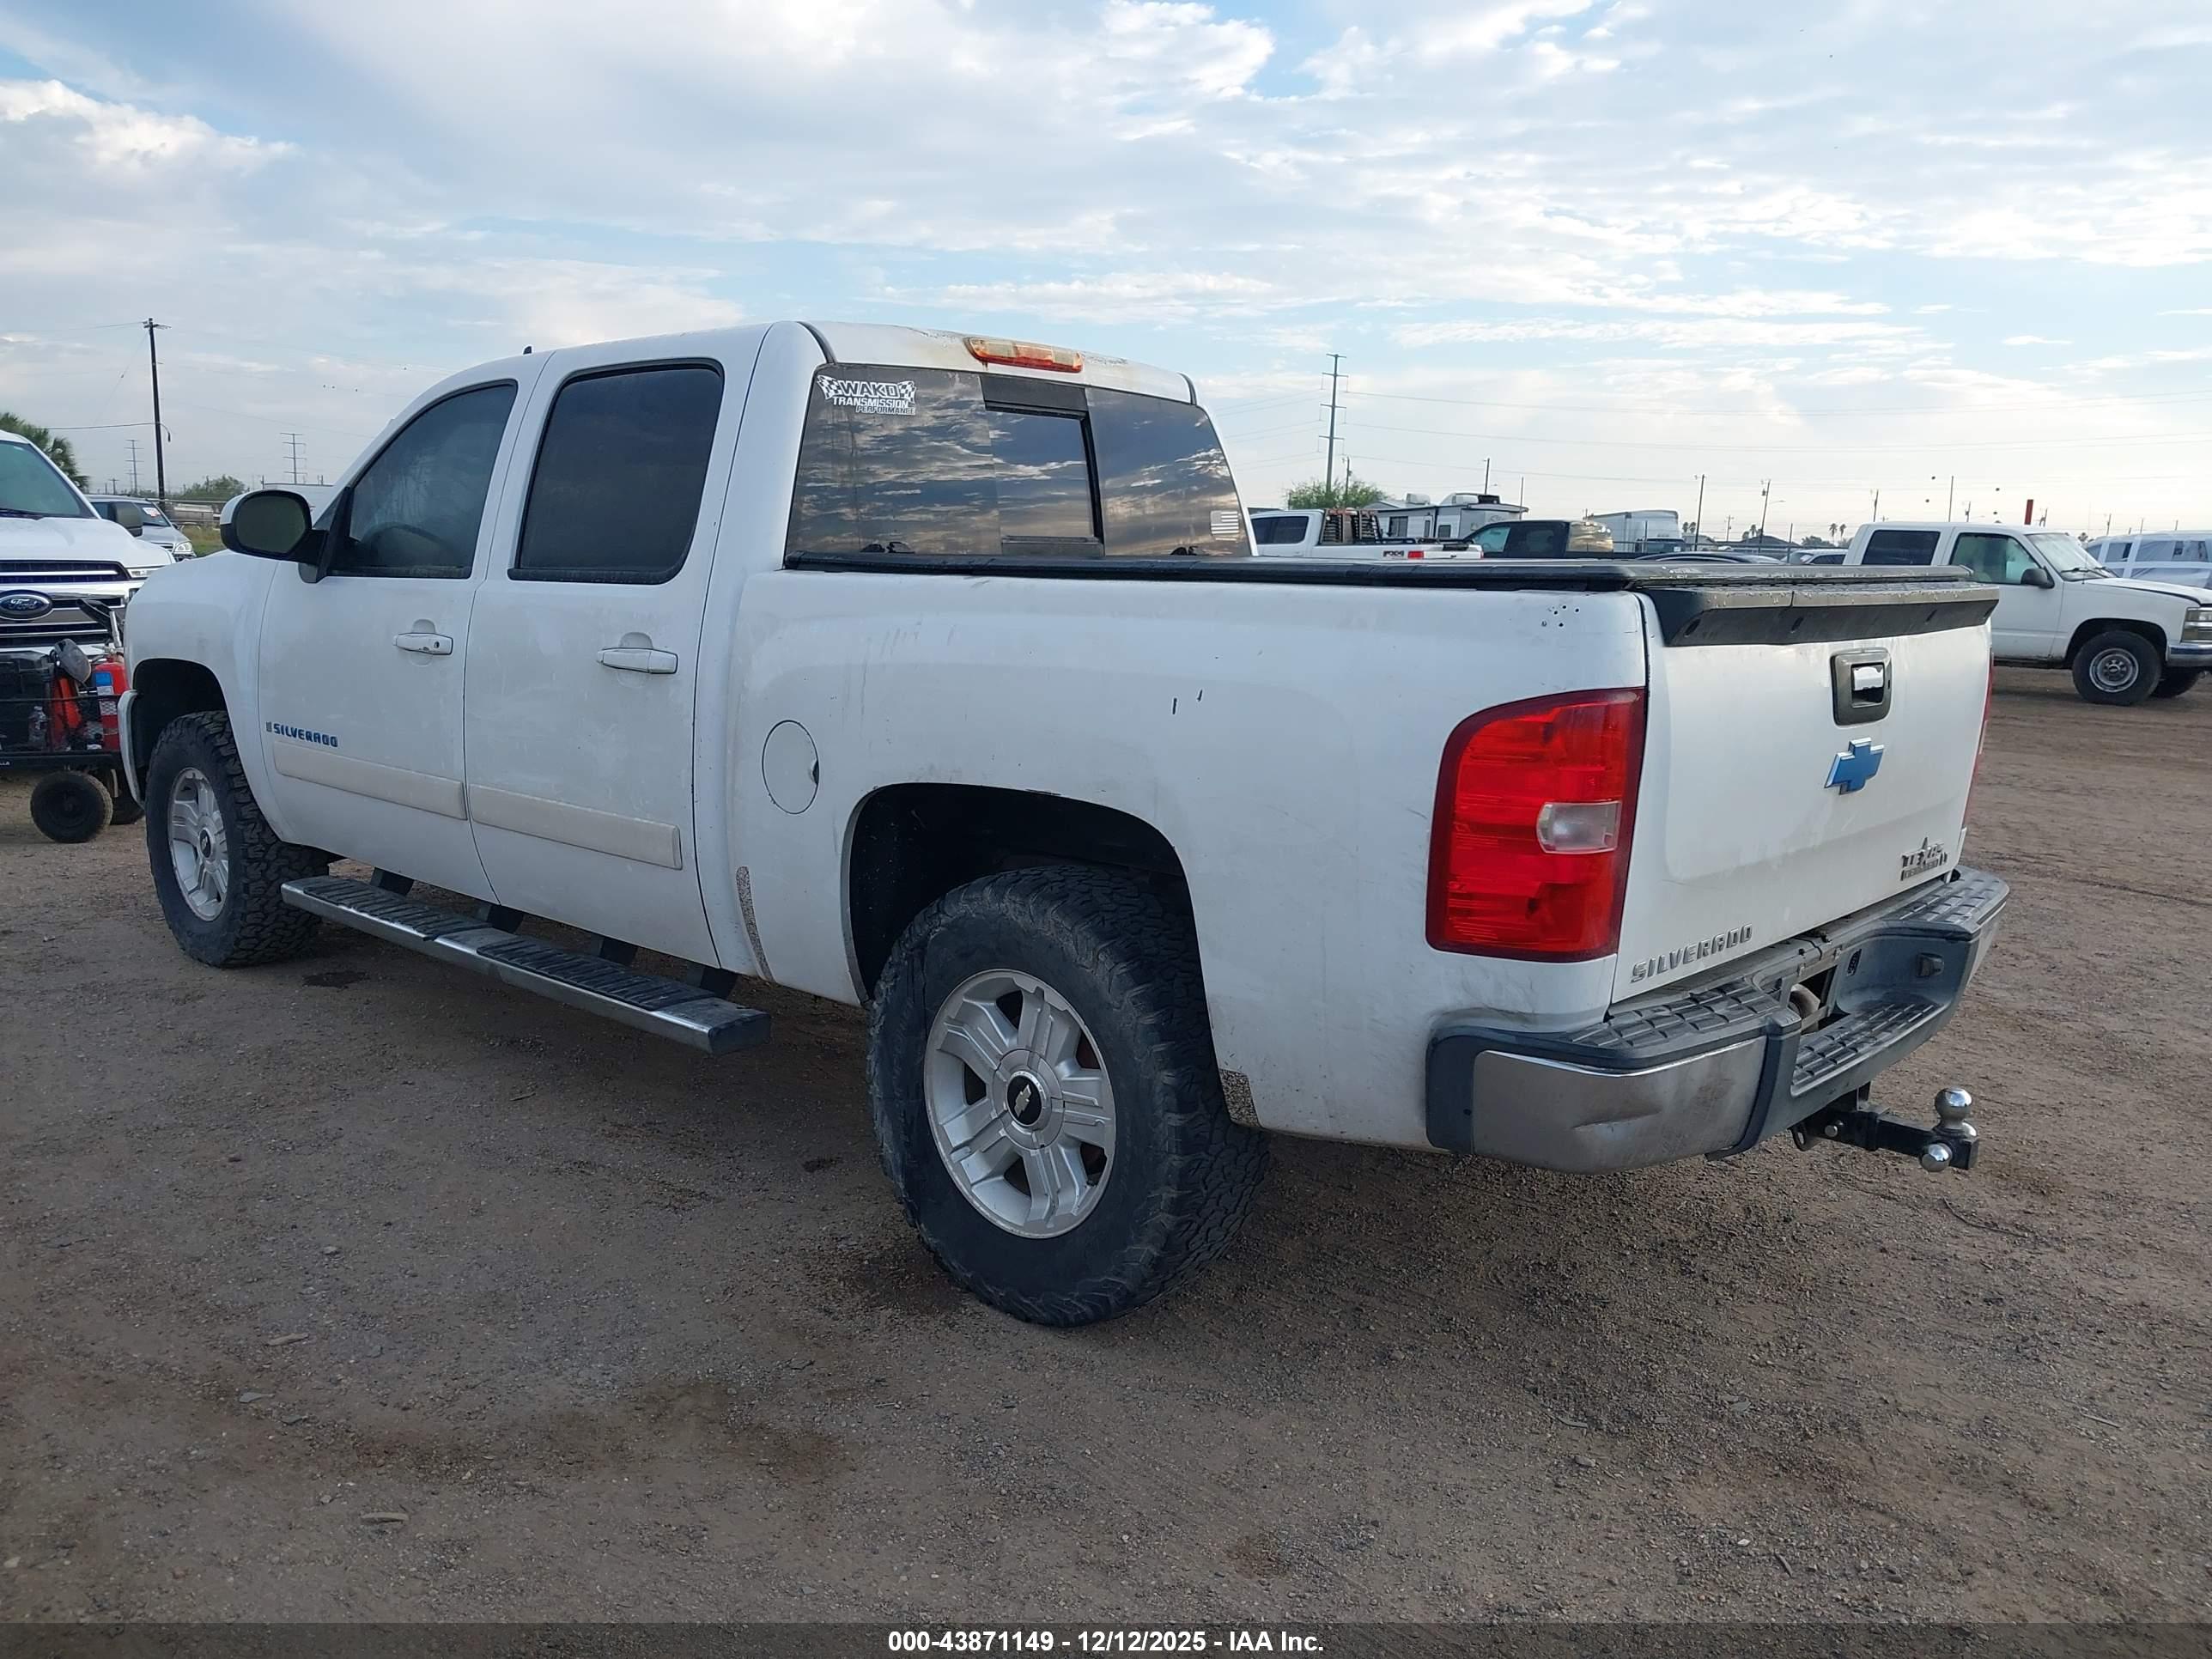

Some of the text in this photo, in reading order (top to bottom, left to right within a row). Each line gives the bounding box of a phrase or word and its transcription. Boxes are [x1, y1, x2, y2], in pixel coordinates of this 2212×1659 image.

[838, 380, 901, 399] WAKO
[832, 396, 909, 409] TRANSMISSION
[855, 404, 916, 416] PERFORMANCE
[273, 723, 338, 748] SILVERADO
[1630, 923, 1753, 983] SILVERADO
